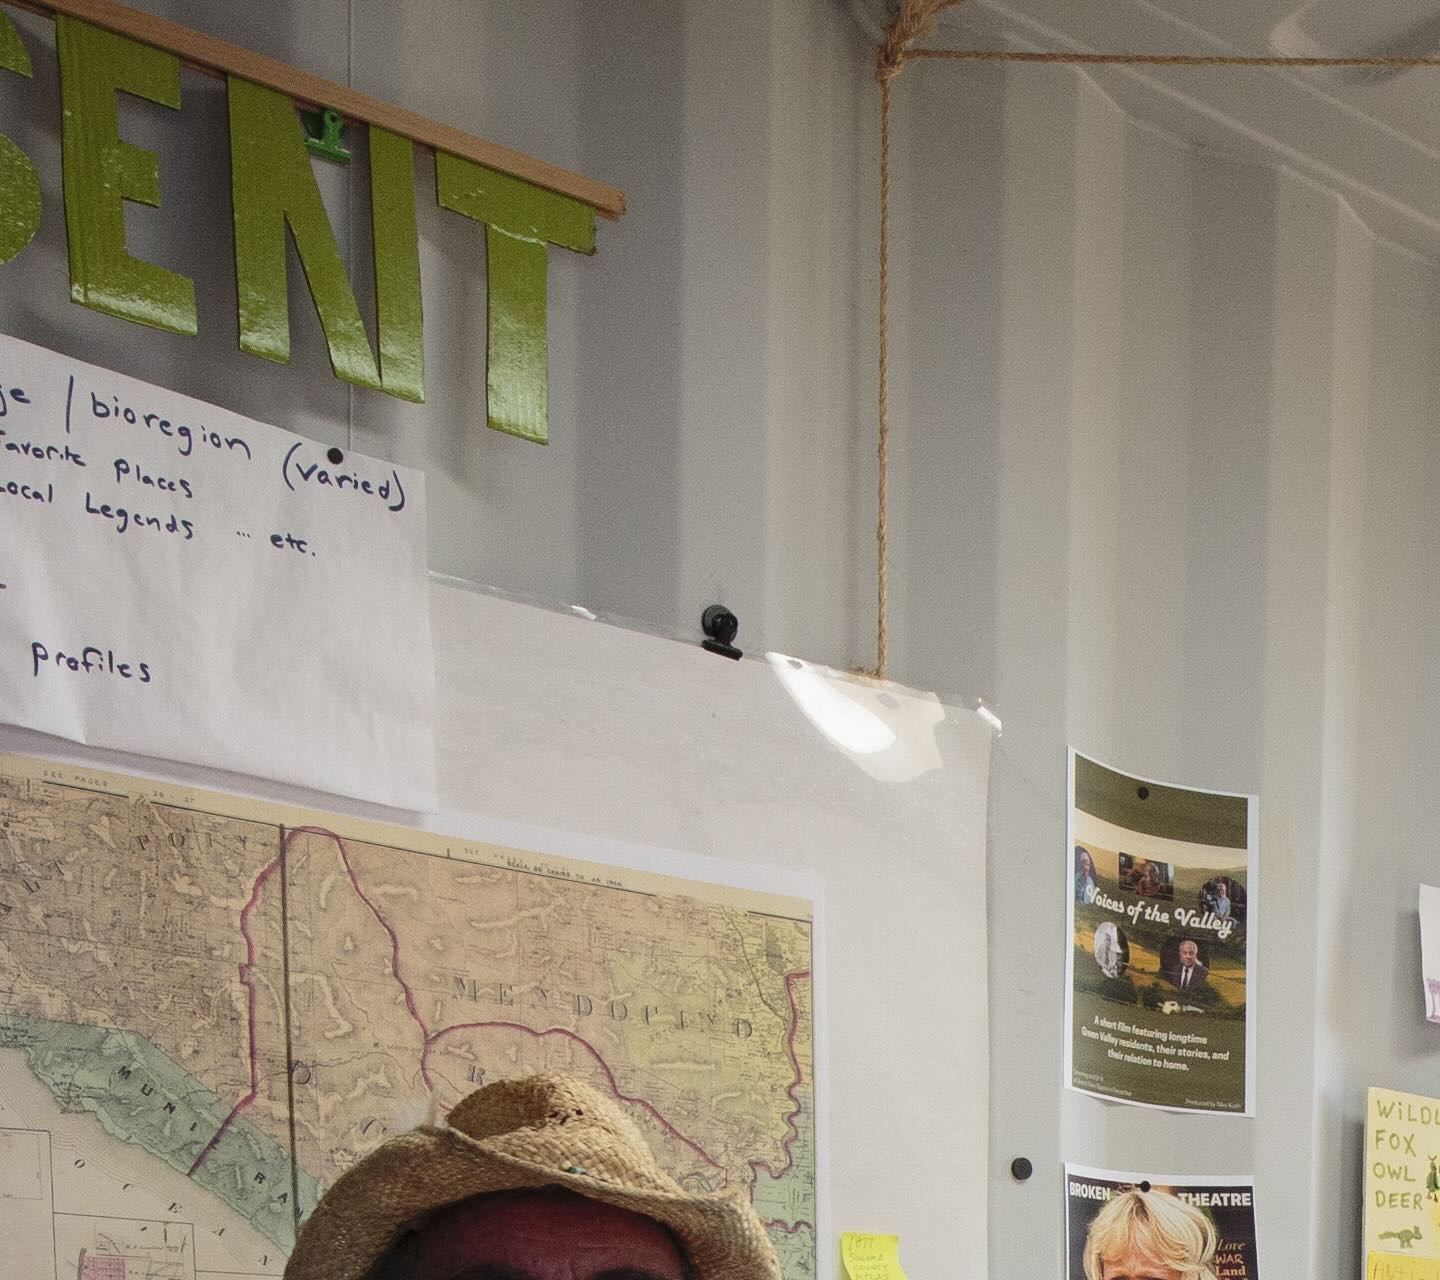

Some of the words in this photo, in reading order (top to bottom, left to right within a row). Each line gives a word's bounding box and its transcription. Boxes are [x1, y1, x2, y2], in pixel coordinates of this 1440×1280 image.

[91, 391, 252, 461] bioregion
[281, 441, 405, 512] (varied)
[85, 491, 194, 540] Legends
[268, 532, 317, 558] etc.
[31, 640, 153, 685] profiles
[1085, 884, 1126, 914] Voices
[1126, 900, 1144, 925] of
[1143, 904, 1170, 924] the
[1174, 906, 1233, 939] Valley
[1168, 1031, 1208, 1045] longtime
[1212, 1050, 1231, 1061] and
[1375, 1129, 1417, 1157] FOX
[1372, 1162, 1417, 1182] OWL
[1069, 1181, 1111, 1201] BROKEN
[1178, 1192, 1252, 1208] THEATRE
[1375, 1189, 1424, 1211] DEER
[1215, 1239, 1246, 1252] Love
[1216, 1265, 1246, 1277] Land
